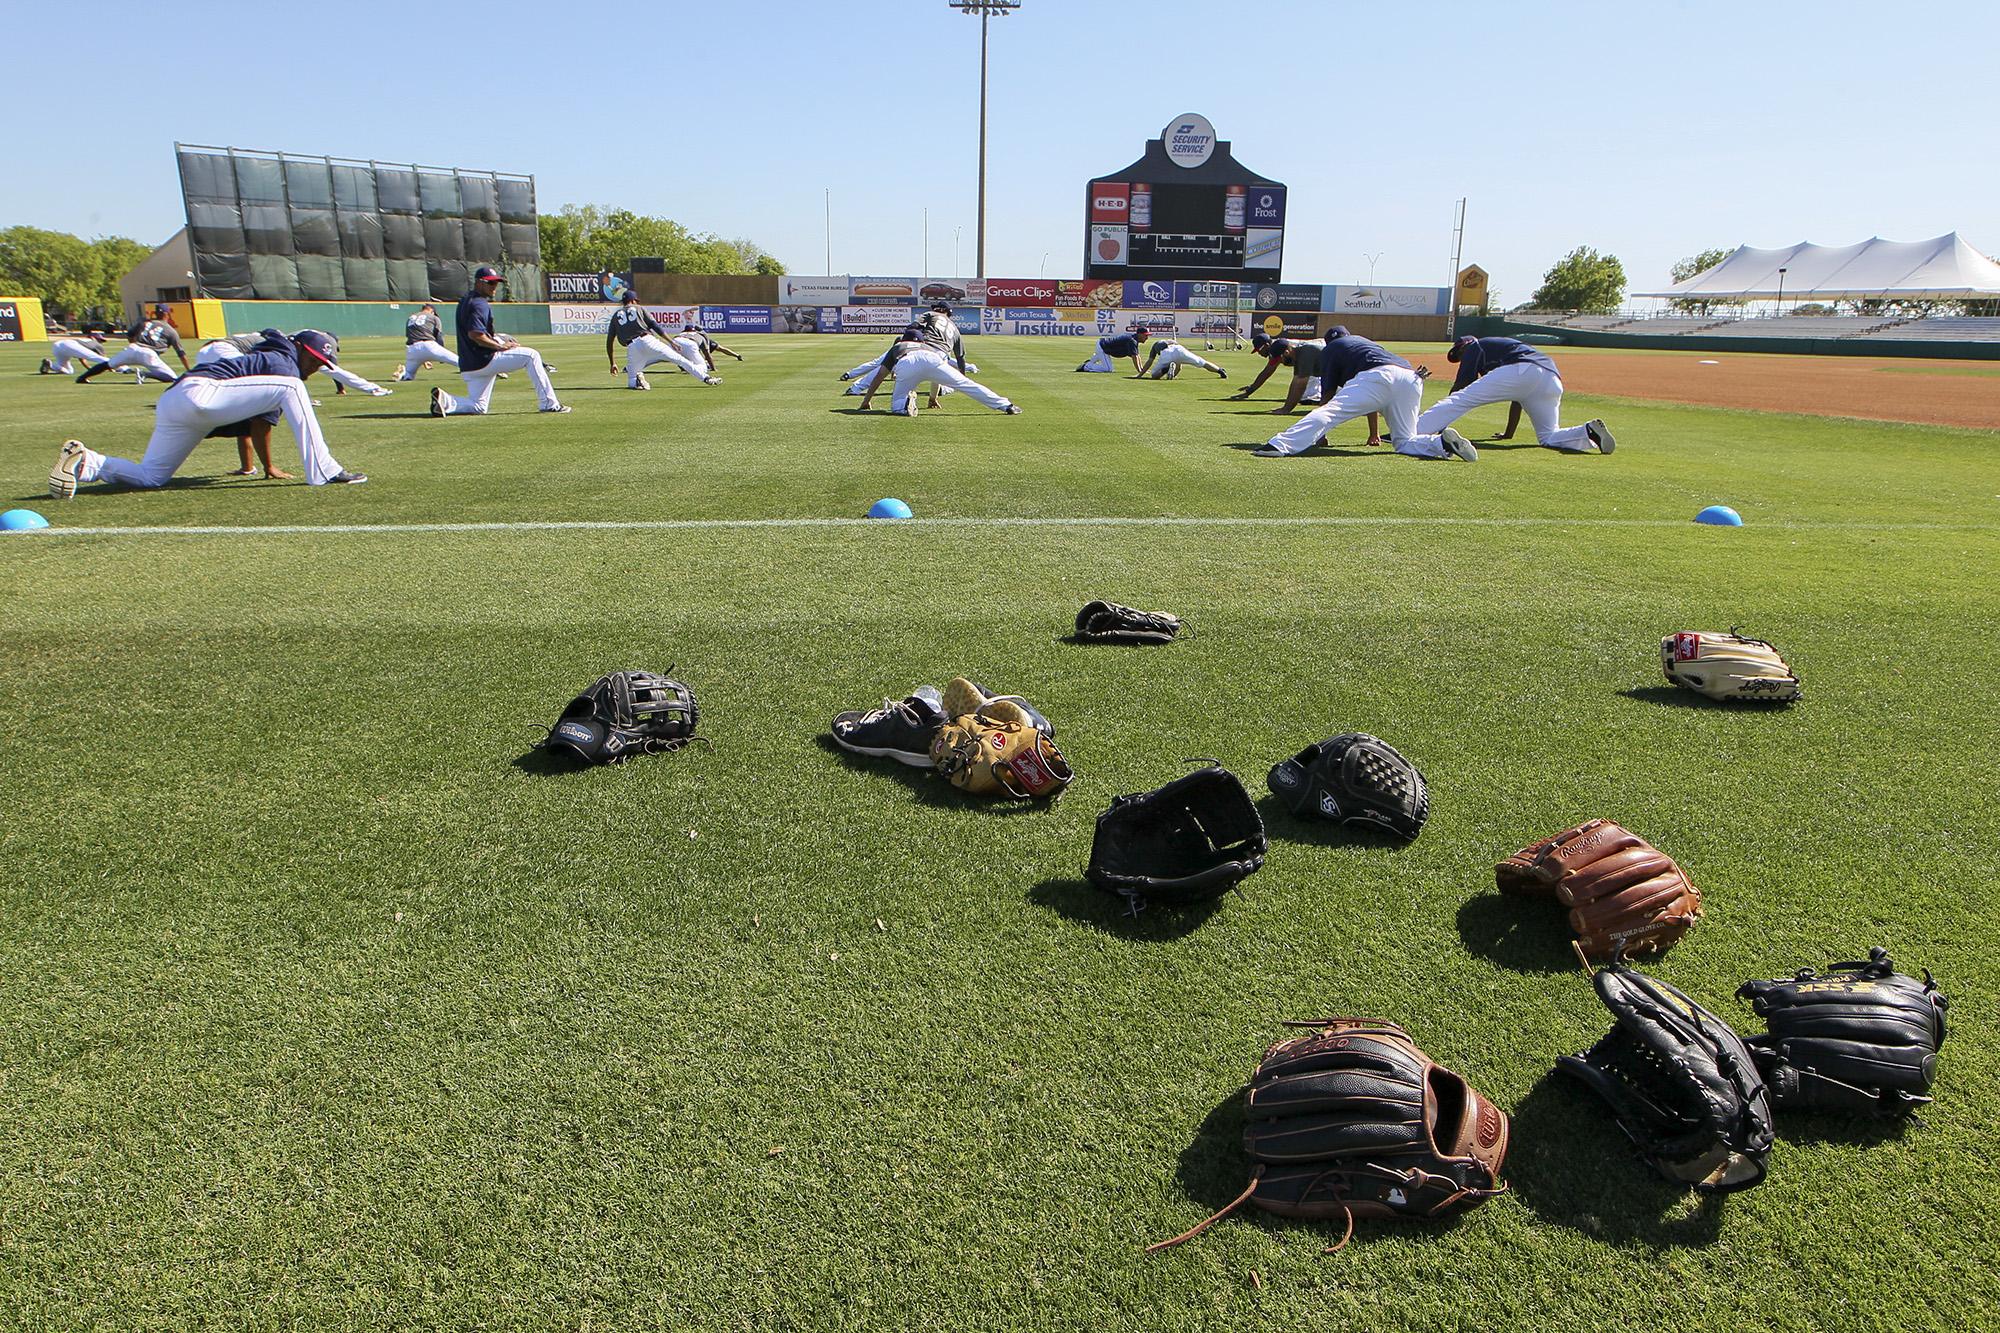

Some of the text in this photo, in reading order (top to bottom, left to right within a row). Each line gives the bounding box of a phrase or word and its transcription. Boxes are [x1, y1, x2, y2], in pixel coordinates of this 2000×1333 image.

[1172, 135, 1211, 144] SECURITY
[1172, 144, 1205, 153] SERVICE
[1255, 208, 1277, 217] Frost
[550, 277, 599, 293] HENRY'S
[987, 286, 1021, 297] Great
[1023, 286, 1052, 299] Clips
[564, 307, 598, 322] Daisy
[703, 312, 724, 320] BUD
[1014, 321, 1085, 336] Institute
[559, 725, 591, 741] Wilson
[1560, 831, 1605, 858] Rawlings
[1609, 932, 1621, 940] THE
[1622, 928, 1638, 937] GOLD
[1638, 924, 1656, 933] GLOVE
[1797, 983, 1846, 993] SSK
